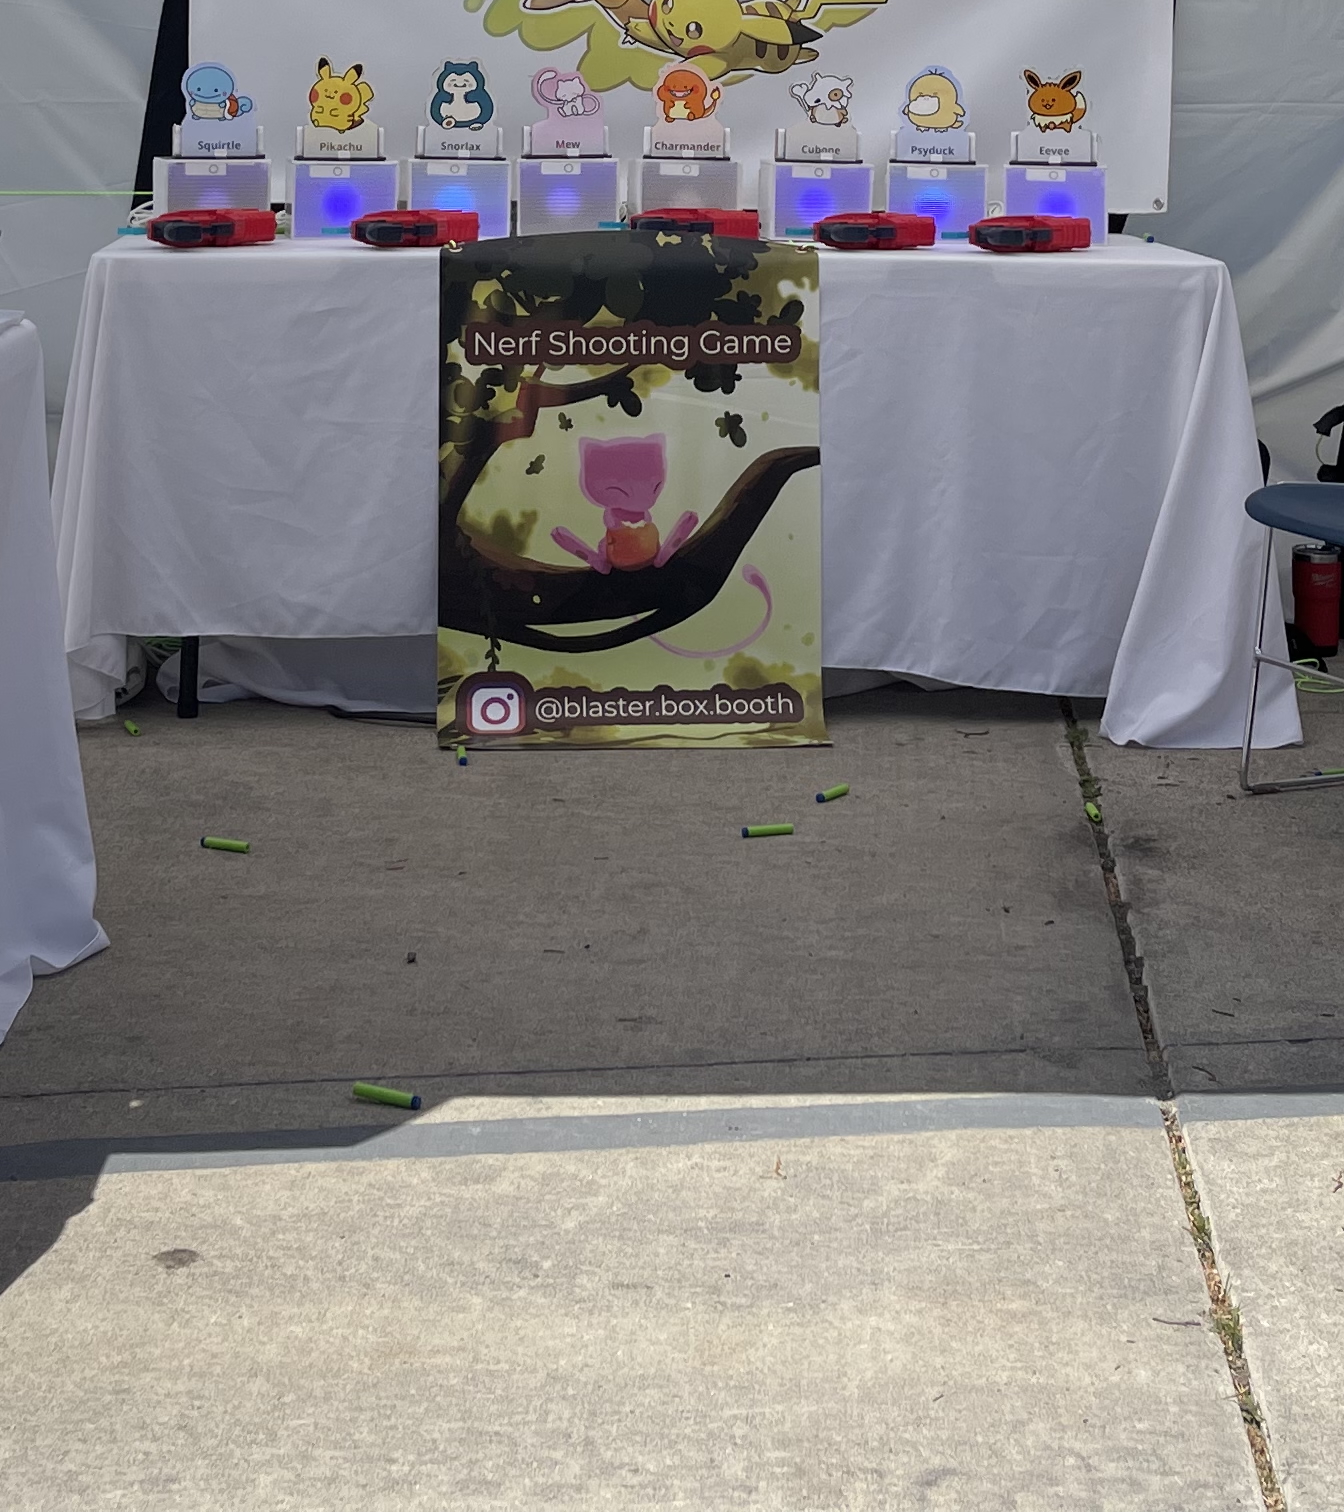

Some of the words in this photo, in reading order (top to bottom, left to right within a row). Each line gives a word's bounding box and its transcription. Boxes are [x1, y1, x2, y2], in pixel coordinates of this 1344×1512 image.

[197, 138, 241, 152] Squirtle
[319, 140, 363, 153] Pikachu
[440, 140, 482, 153] Snorlax
[555, 139, 581, 150] Mew
[653, 140, 722, 153] Charmander
[801, 144, 841, 156] Cubone
[910, 144, 956, 158] Psyduck
[1039, 145, 1070, 157] Eevee
[473, 329, 541, 358] Nerf
[548, 330, 690, 360] Shooting
[699, 330, 793, 356] Game
[535, 692, 794, 724] @blaster.box.booth
